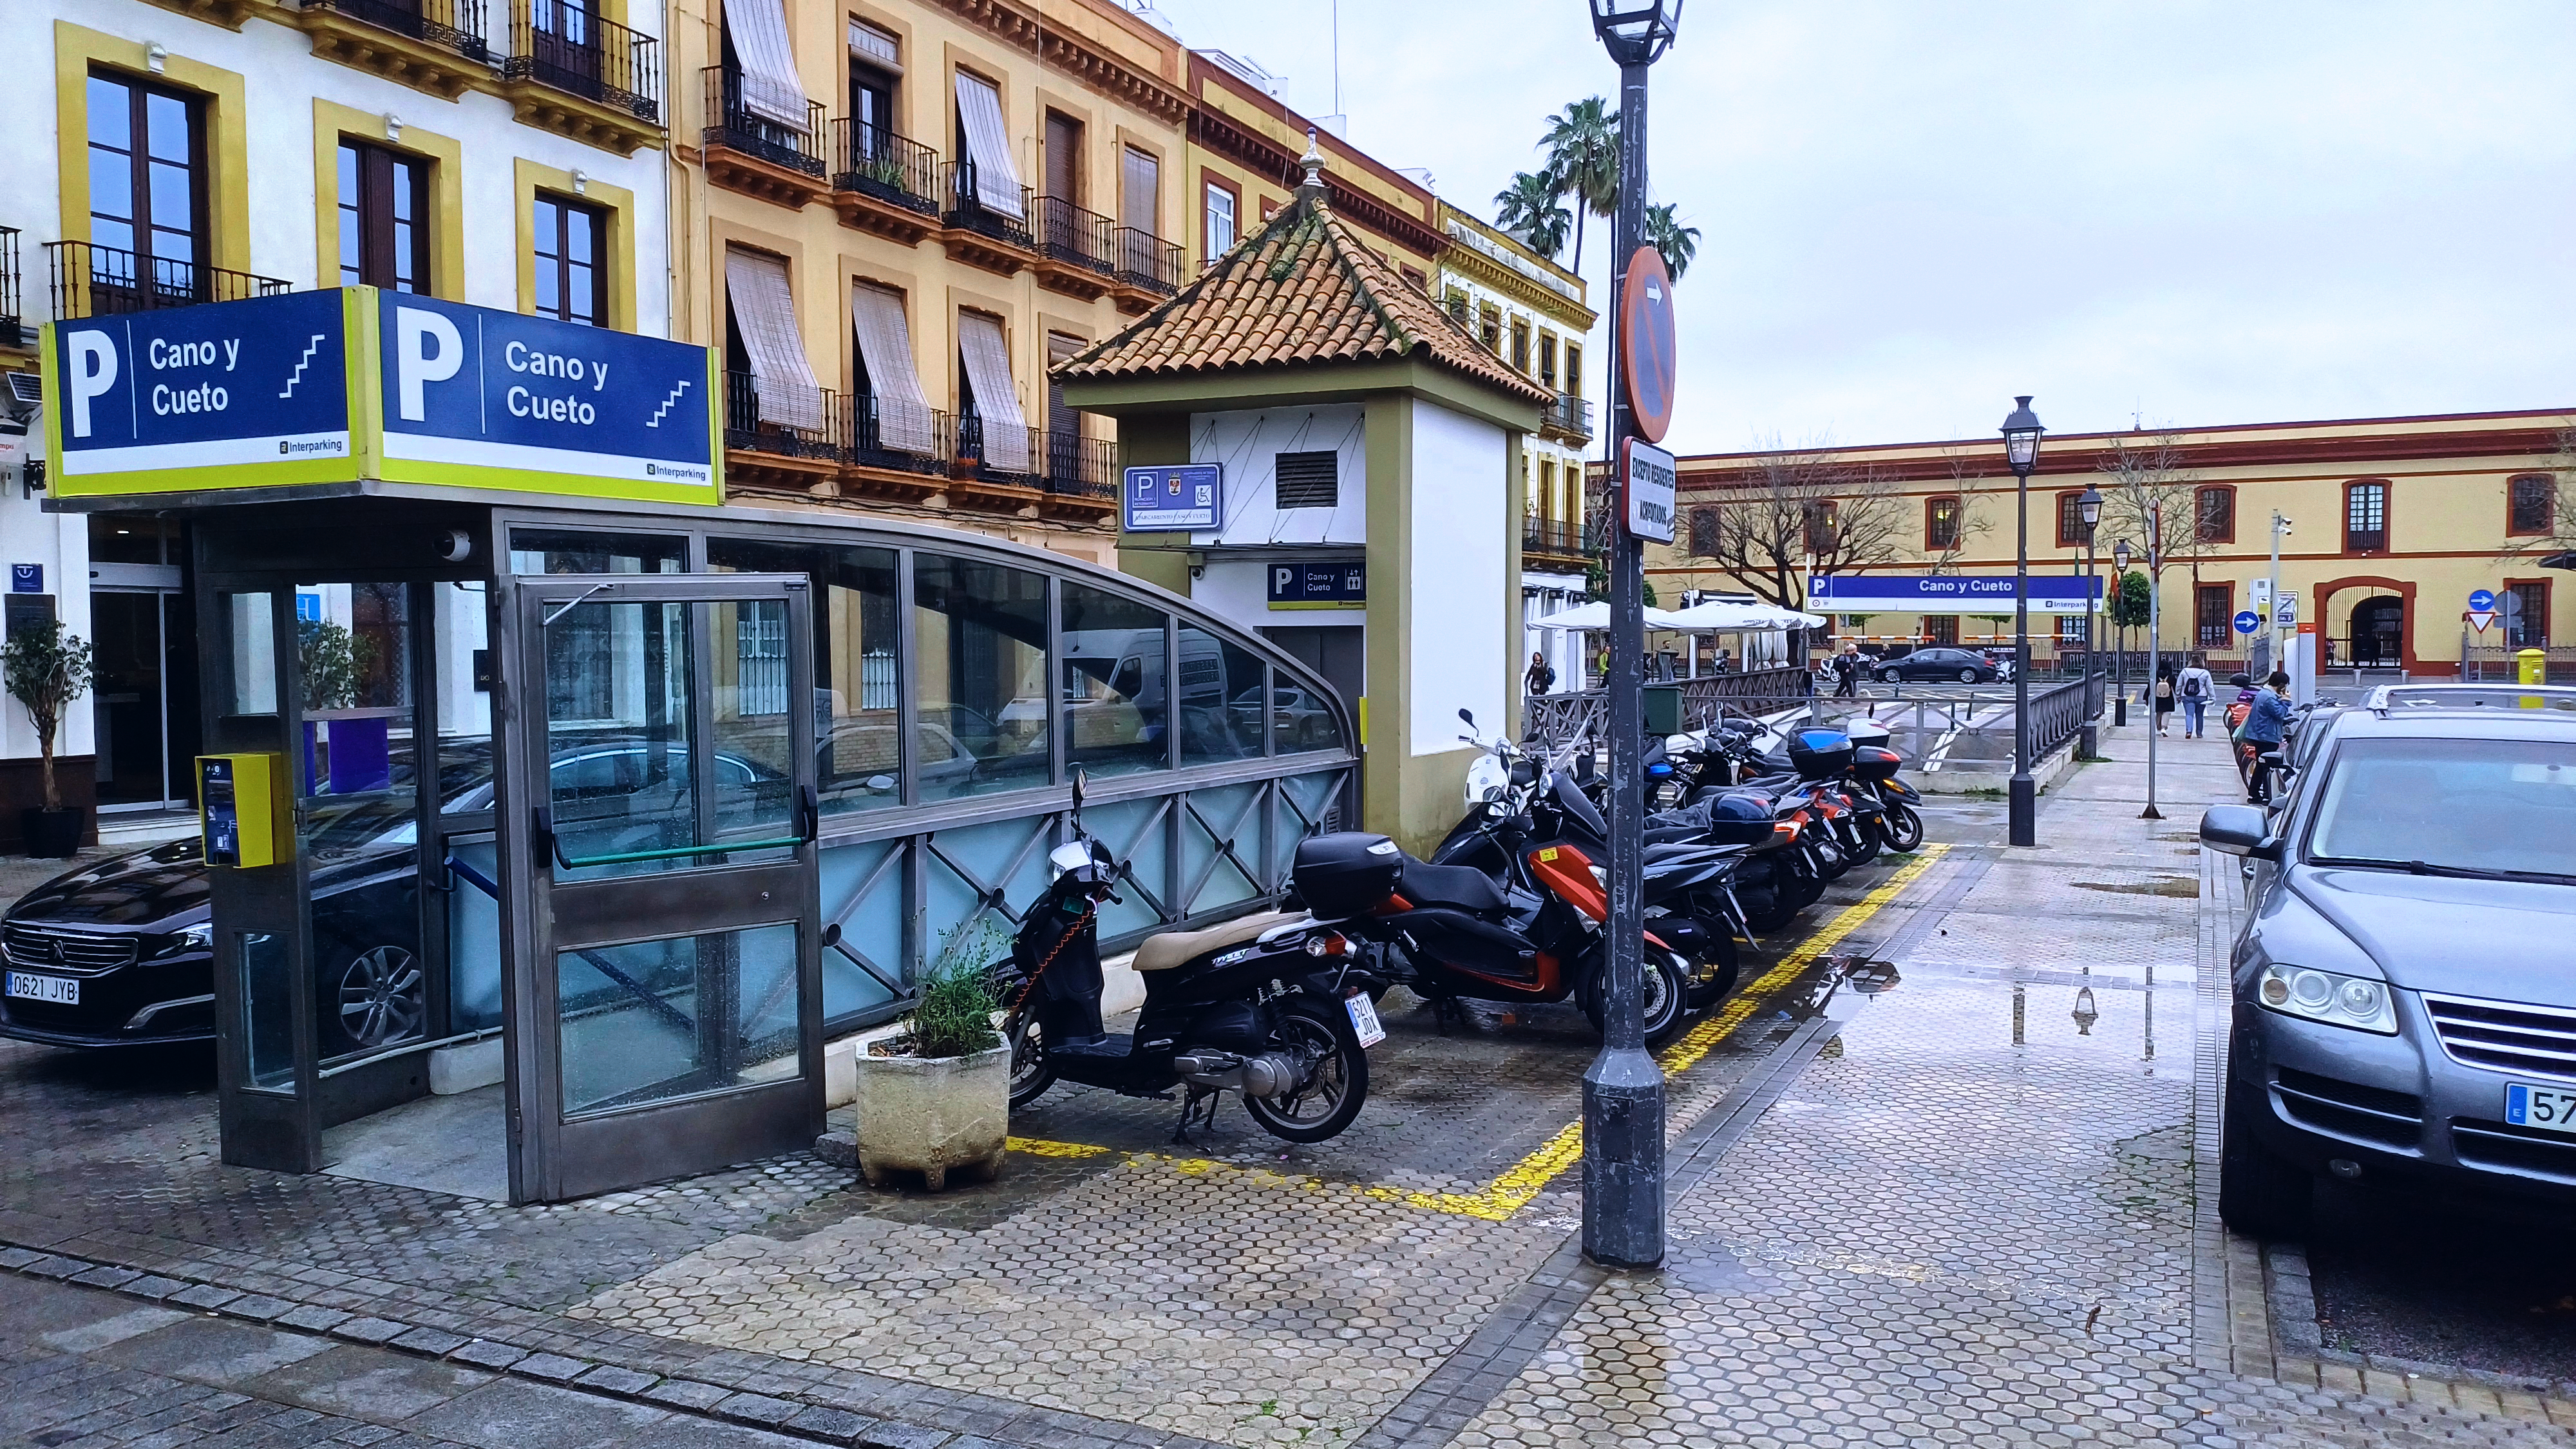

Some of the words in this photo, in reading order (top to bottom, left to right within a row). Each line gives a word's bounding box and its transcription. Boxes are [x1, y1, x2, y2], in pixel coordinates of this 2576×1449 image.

[149, 338, 216, 370] Cano
[223, 338, 240, 372] y
[397, 306, 464, 422] P
[506, 341, 584, 381] Cano
[591, 361, 608, 392] y
[68, 329, 118, 437] P
[152, 381, 229, 415] Cueto
[507, 384, 595, 425] Cueto
[289, 439, 342, 453] Interparking
[656, 465, 706, 481] Interparking
[1633, 457, 1651, 483] EXCEPTO
[1651, 464, 1674, 489] RESIDENTES
[1138, 476, 1153, 498] P
[1640, 500, 1667, 526] ACREDITADOS
[1276, 568, 1293, 594] P
[1814, 578, 1826, 594] P
[1919, 580, 1955, 591] Cano
[1958, 582, 1967, 594] y
[1971, 580, 2012, 591] Cueto
[14, 976, 44, 997] 0621
[51, 980, 75, 1000] JYB
[1353, 998, 1372, 1018] 5211
[1362, 1015, 1379, 1036] JDX
[2513, 1108, 2521, 1117] E
[2533, 1092, 2576, 1124] 57
